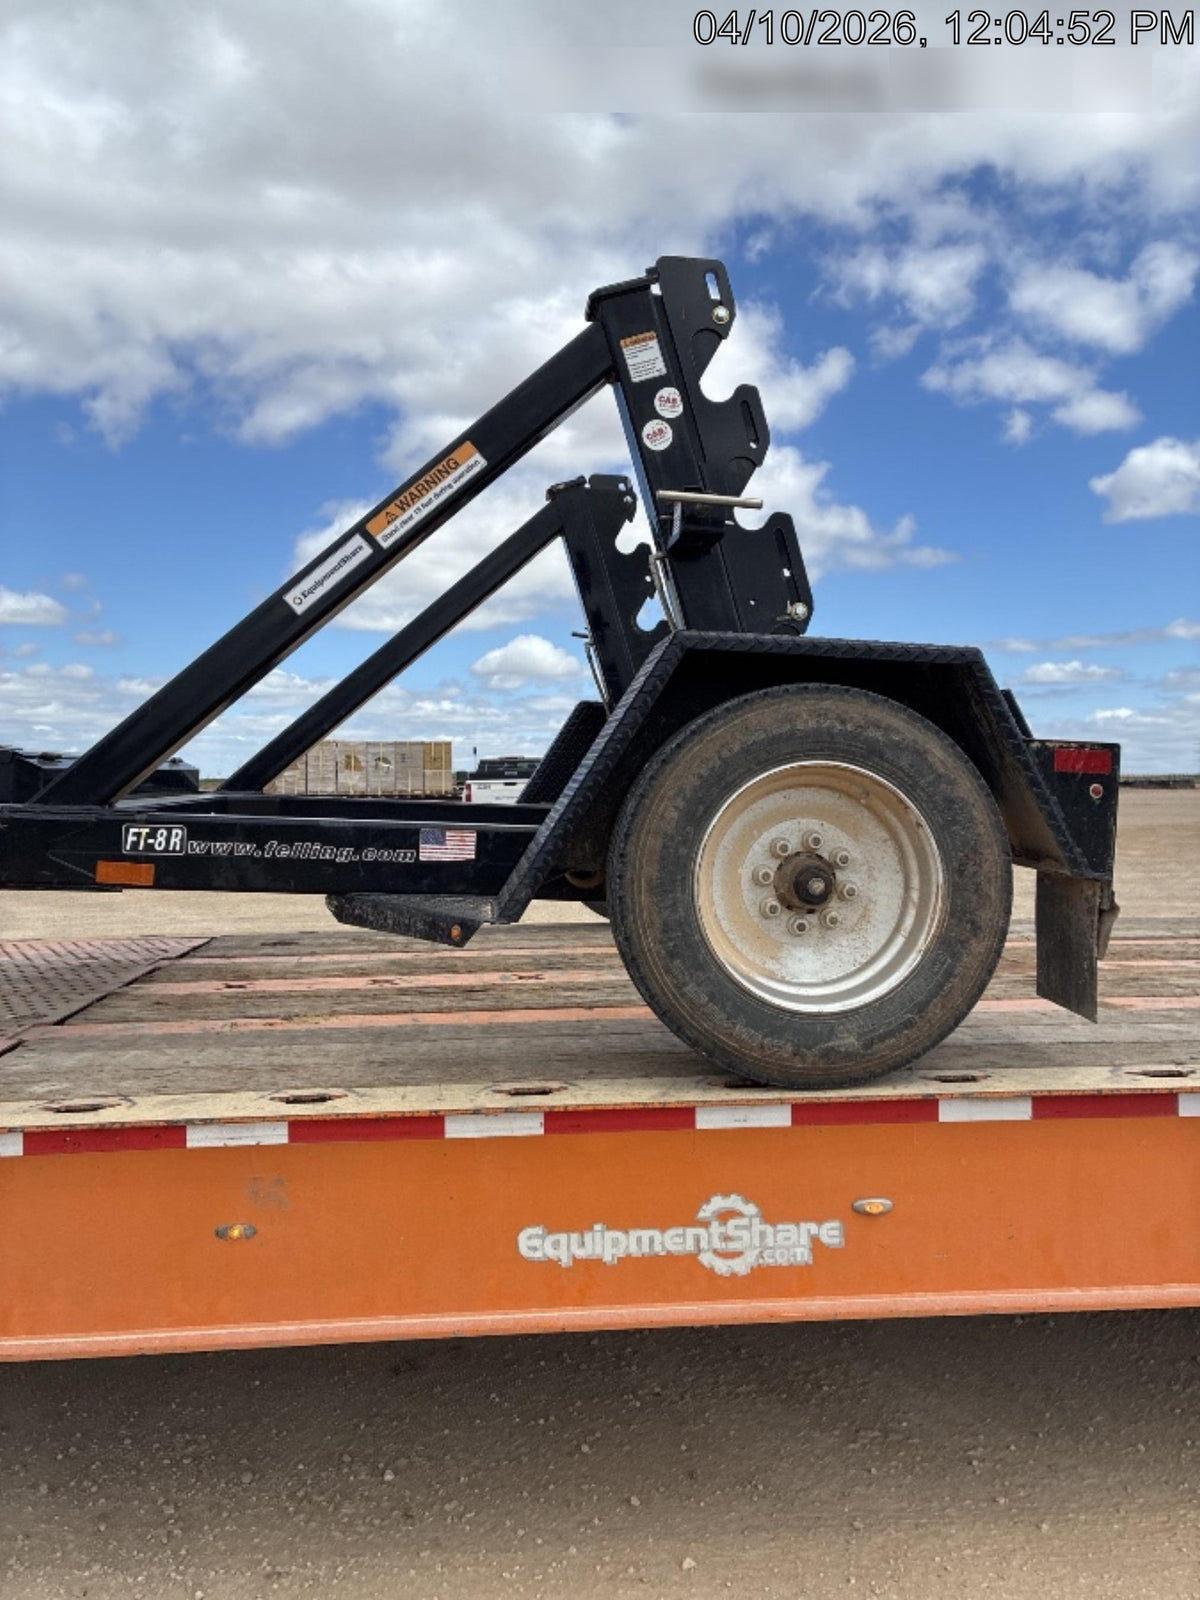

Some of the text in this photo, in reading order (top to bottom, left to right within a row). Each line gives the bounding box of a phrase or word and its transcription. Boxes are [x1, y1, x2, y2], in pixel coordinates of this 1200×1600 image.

[394, 458, 460, 512] WARNING
[187, 840, 417, 863] www.felling.com
[517, 1217, 844, 1268] EquipmentShare
